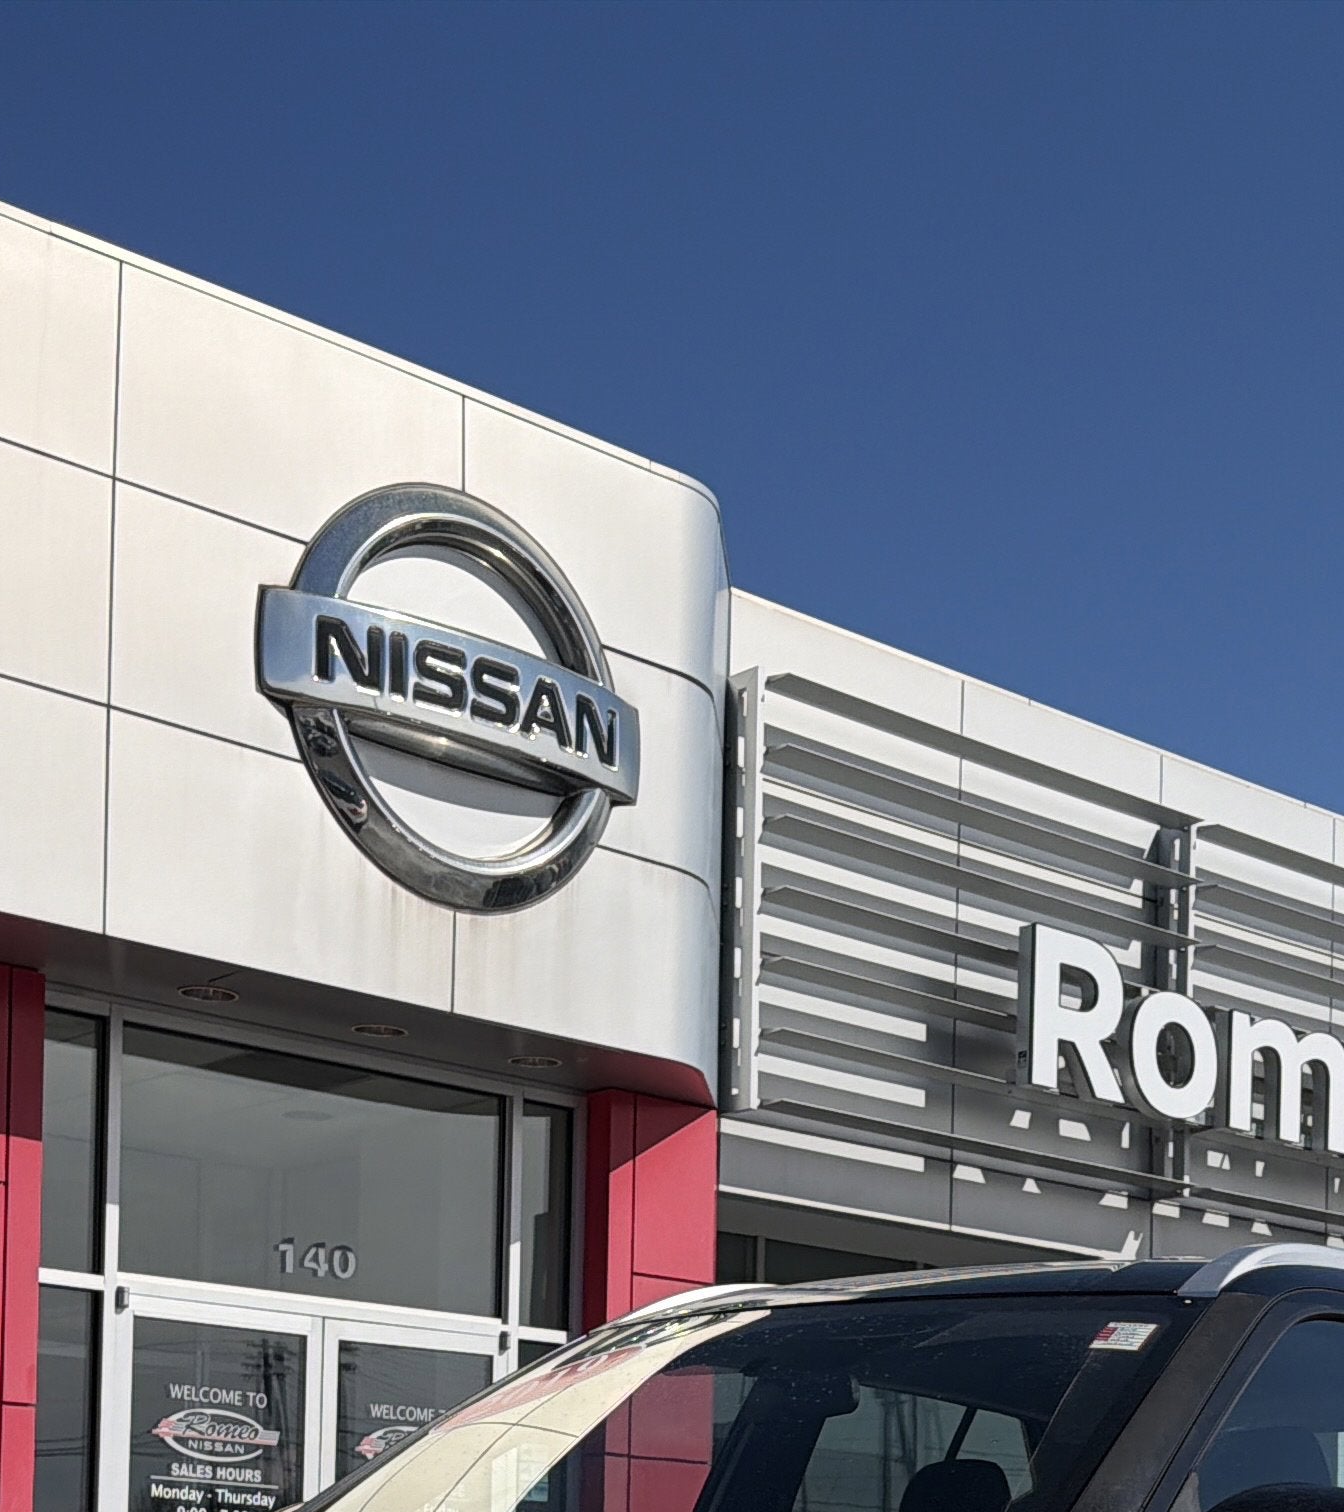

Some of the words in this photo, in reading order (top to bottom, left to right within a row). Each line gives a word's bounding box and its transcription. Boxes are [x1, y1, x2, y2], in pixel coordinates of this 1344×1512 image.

[314, 613, 620, 772] NISSAN
[274, 1239, 357, 1279] 140
[169, 1382, 243, 1407] WELCOME
[246, 1391, 268, 1409] TO
[176, 1411, 260, 1440] Romeo
[370, 1403, 435, 1422] WELCOME
[188, 1439, 245, 1454] NISSAN
[171, 1462, 213, 1478] SALES
[216, 1466, 262, 1483] HOURS
[150, 1483, 205, 1503] Monday
[215, 1488, 277, 1510] Thursday
